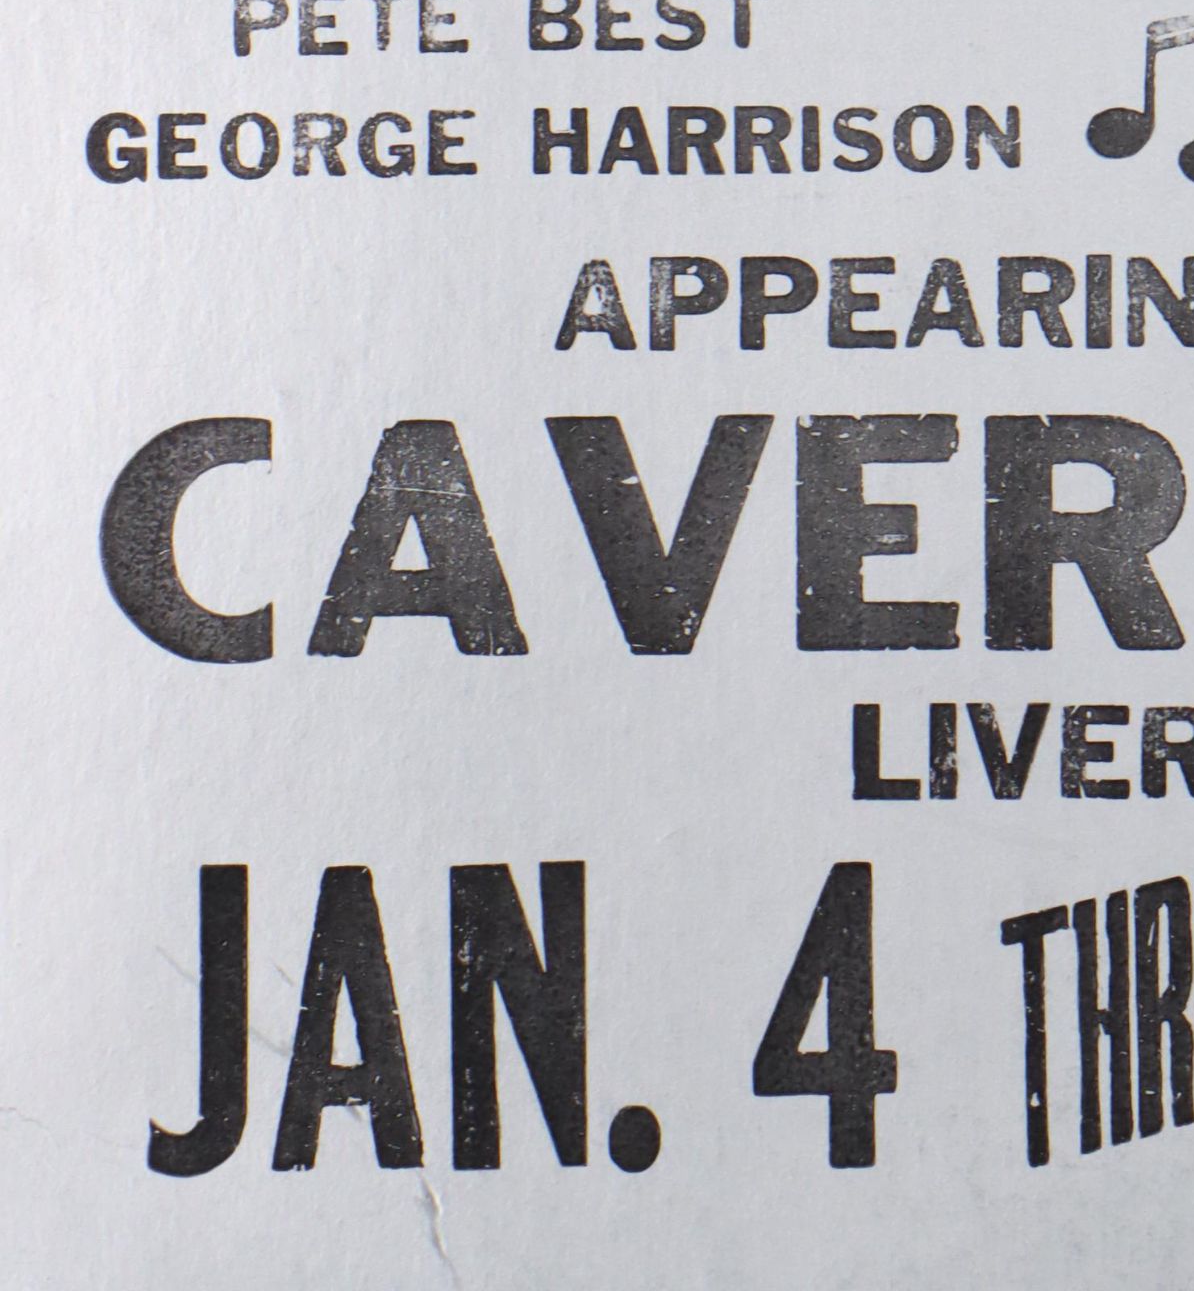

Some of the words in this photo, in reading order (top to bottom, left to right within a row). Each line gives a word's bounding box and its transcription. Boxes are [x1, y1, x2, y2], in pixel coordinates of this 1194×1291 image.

[86, 110, 477, 183] GEORGE
[533, 105, 1020, 175] HARRISON
[147, 860, 661, 1177] JAN.
[752, 861, 897, 1169] 4
